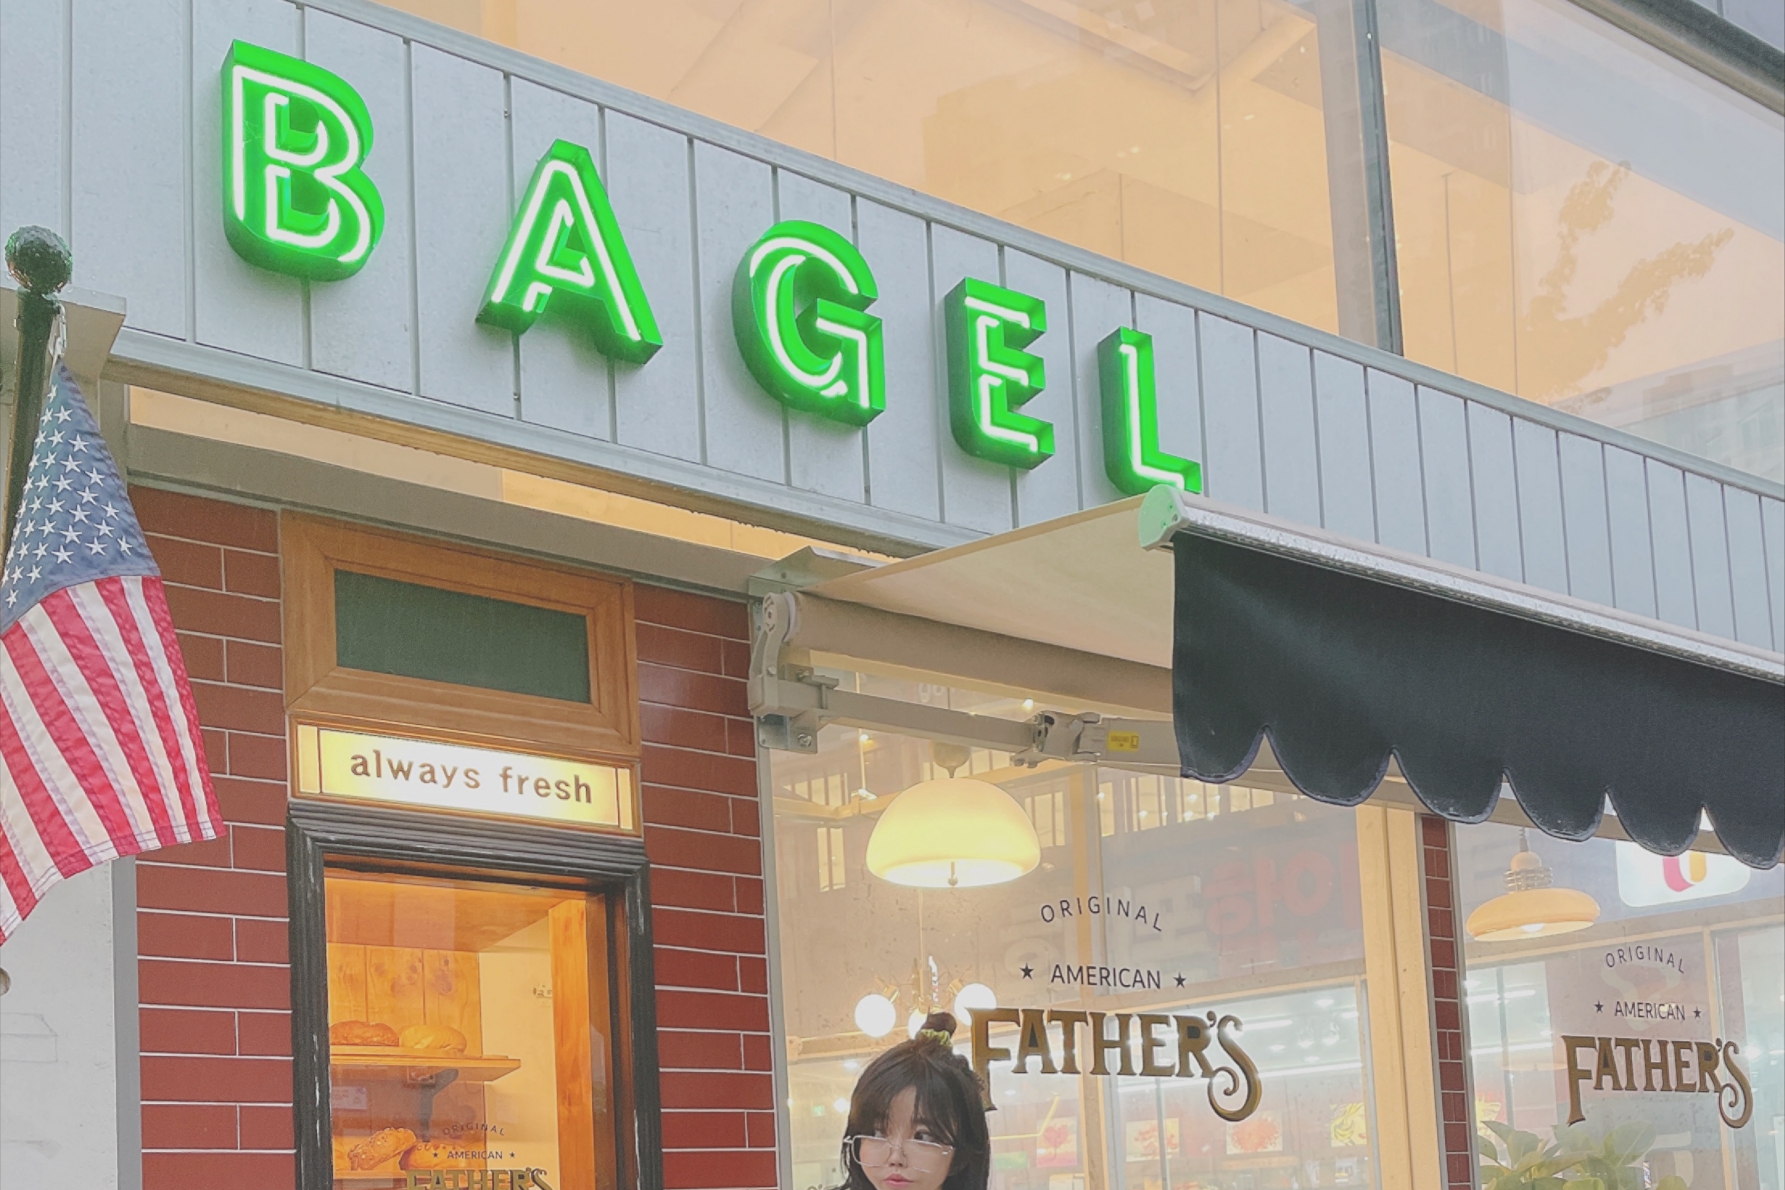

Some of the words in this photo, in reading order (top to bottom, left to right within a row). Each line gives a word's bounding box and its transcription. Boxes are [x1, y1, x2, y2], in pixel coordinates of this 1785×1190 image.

[220, 39, 1202, 494] BAGEL
[350, 749, 480, 789] always
[499, 766, 592, 804] fresh
[1040, 896, 1162, 932] ORIGINAL
[1605, 945, 1685, 974] ORIGINAL
[1050, 964, 1161, 989] AMERICAN
[1614, 1001, 1685, 1021] AMERICAN
[965, 1007, 1262, 1122] FATHER'S
[1561, 1035, 1753, 1129] FATHER'S
[442, 1122, 505, 1136] ORIGINAL
[447, 1151, 503, 1159] AMERICAN
